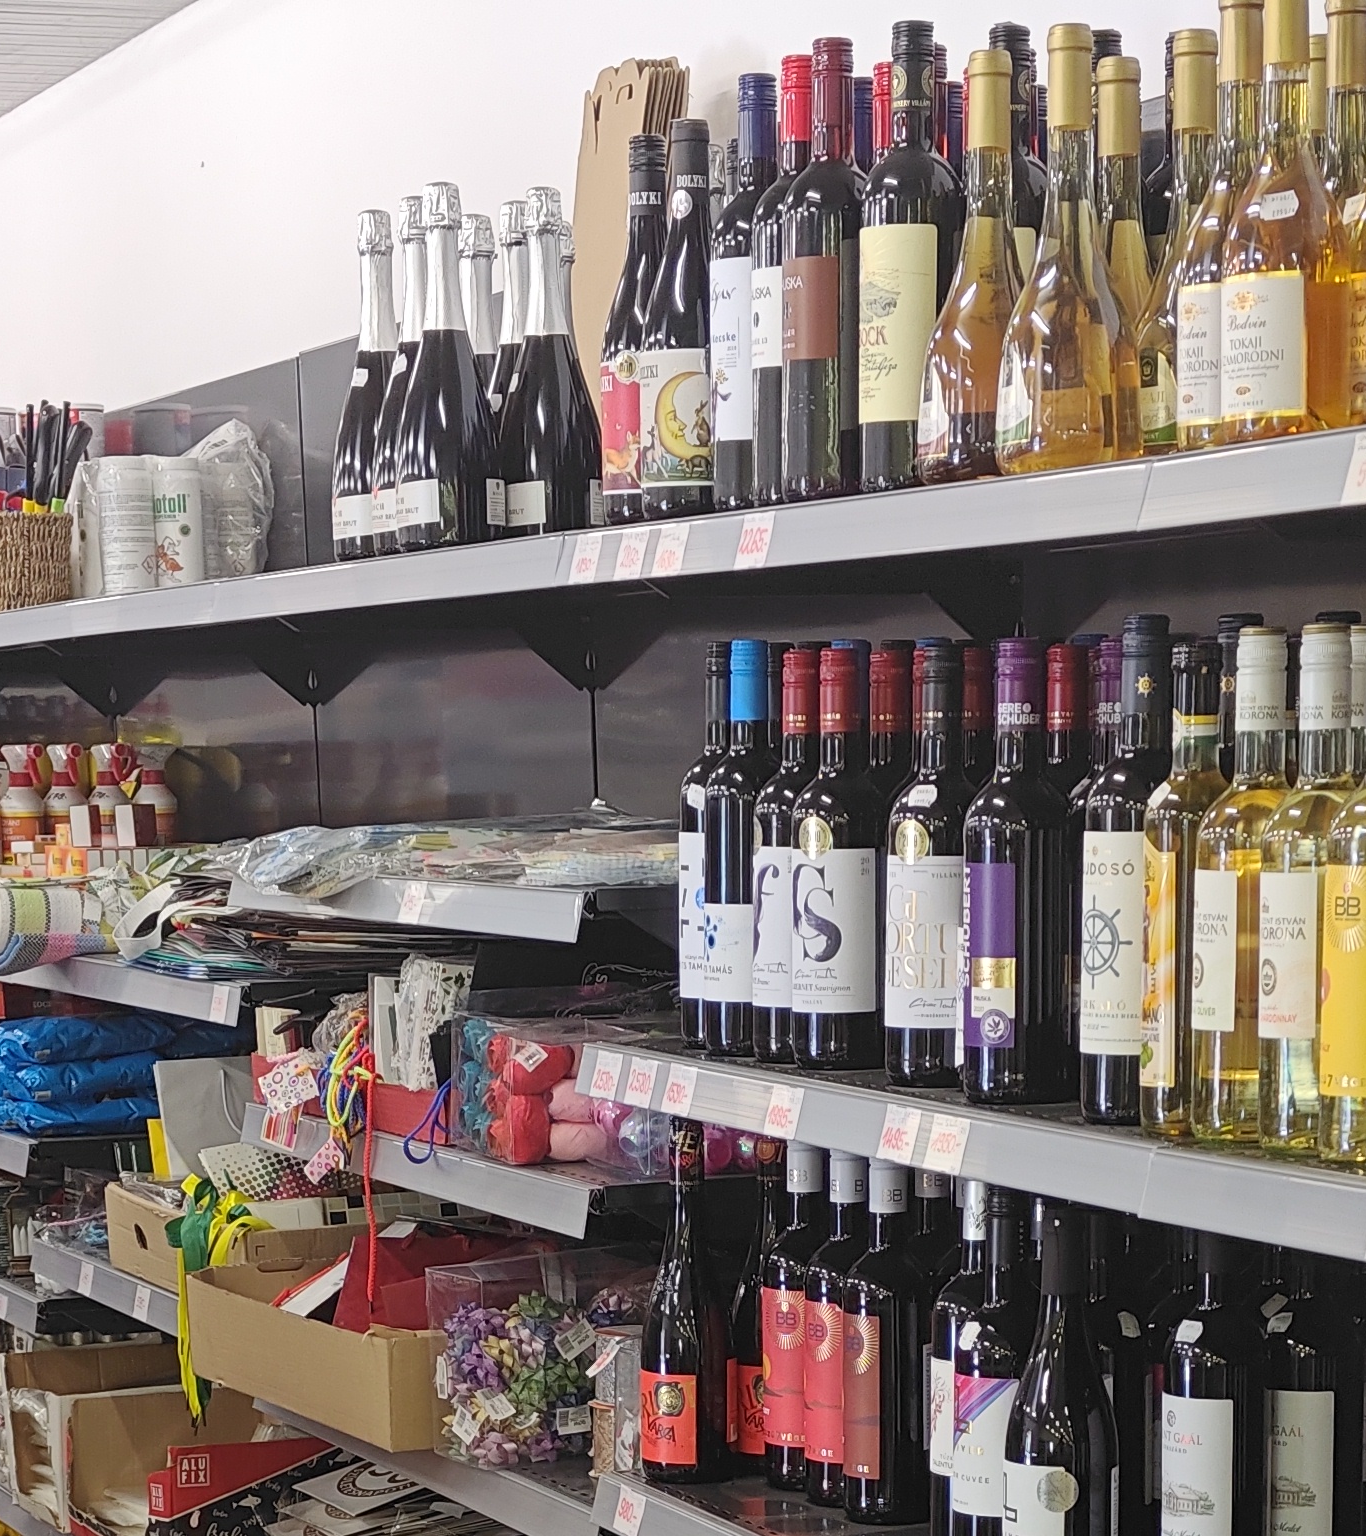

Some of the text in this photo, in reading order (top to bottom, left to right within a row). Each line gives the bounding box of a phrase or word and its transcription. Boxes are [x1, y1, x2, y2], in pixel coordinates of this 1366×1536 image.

[677, 175, 706, 188] BOLYKI
[1229, 336, 1262, 350] TOKAJI
[1335, 897, 1360, 916] BB
[1275, 917, 1306, 925] ISTVÁN
[775, 1312, 796, 1325] BB
[1173, 1432, 1202, 1446] GAÁL
[181, 1458, 205, 1471] ALU
[181, 1471, 205, 1484] FIX
